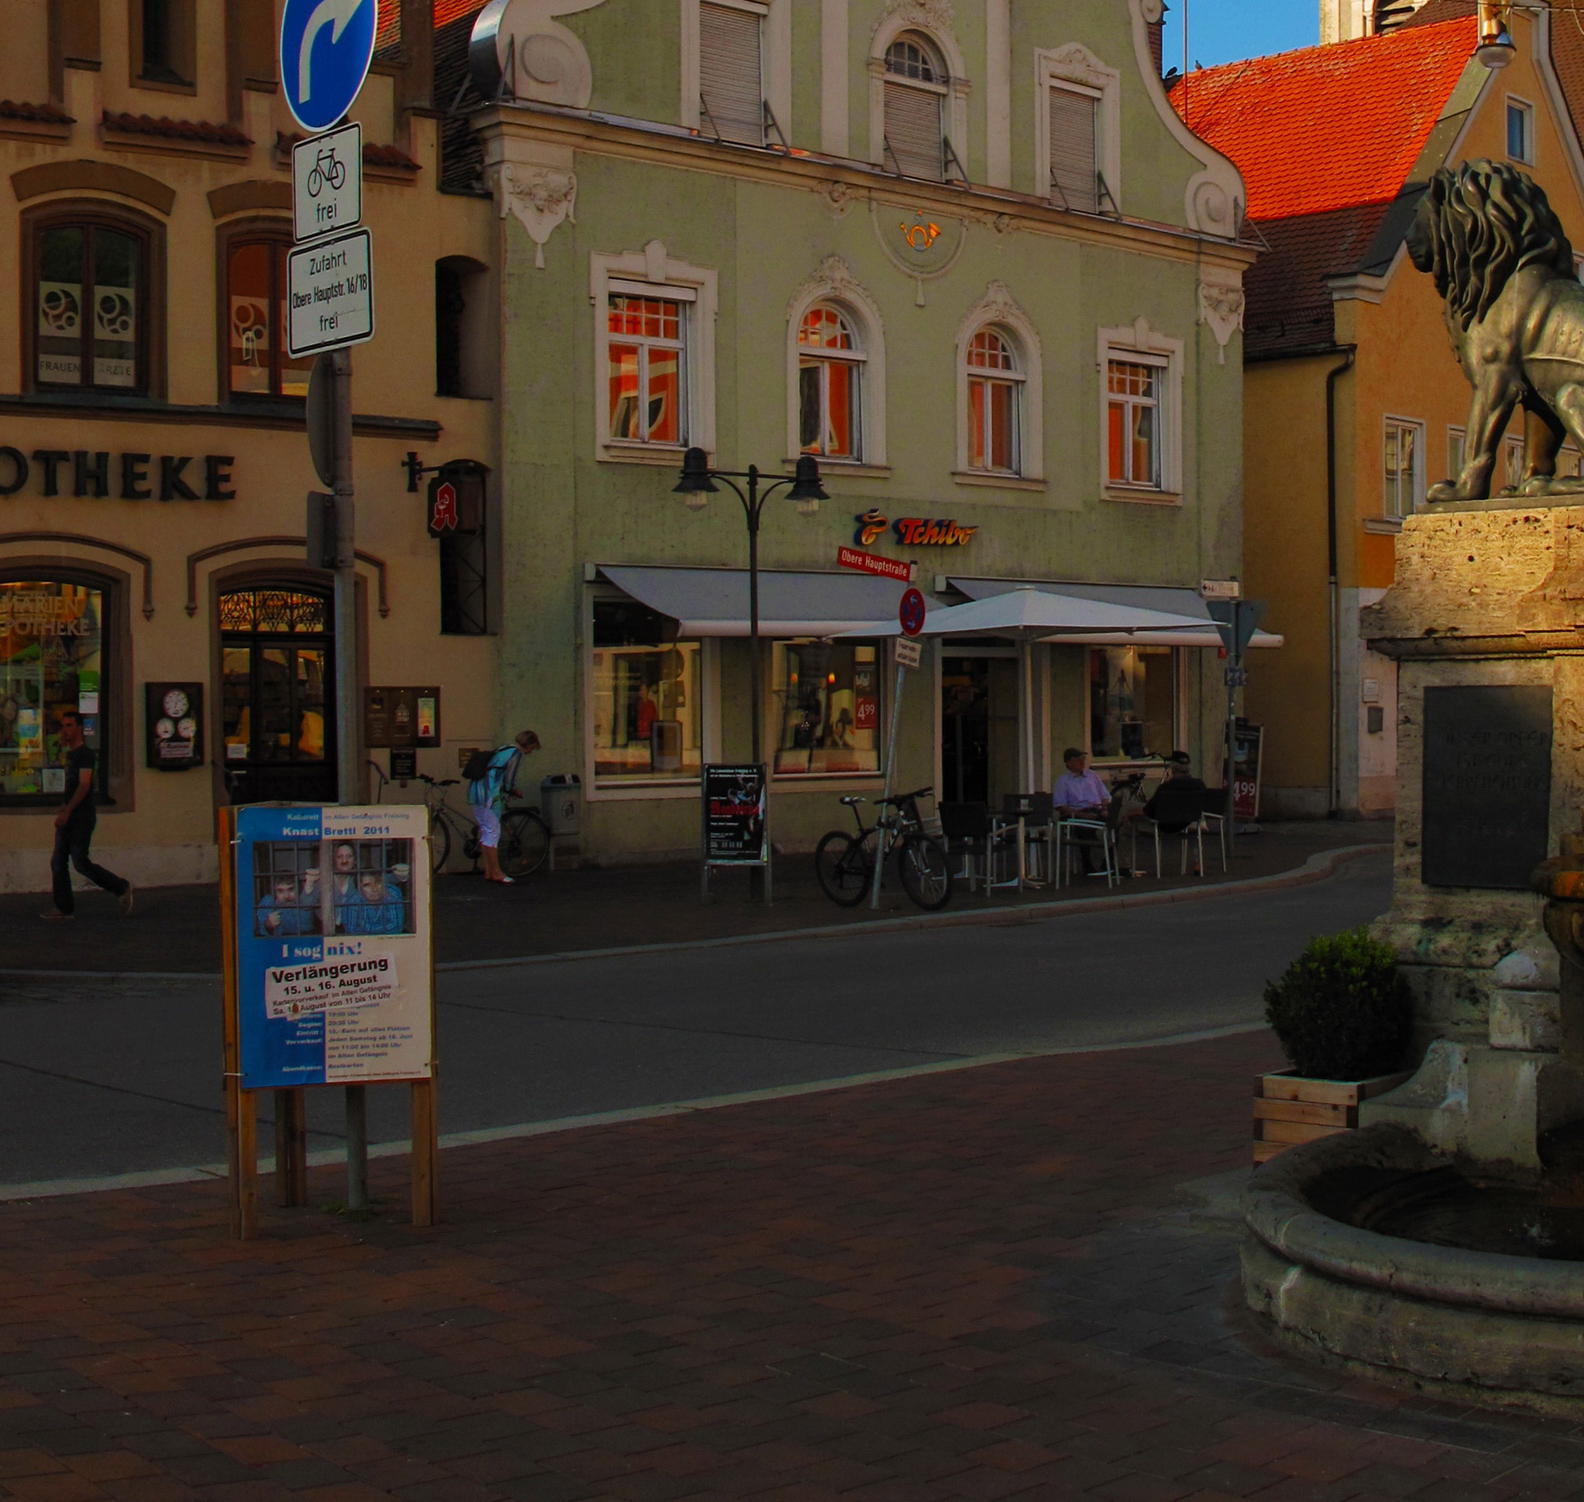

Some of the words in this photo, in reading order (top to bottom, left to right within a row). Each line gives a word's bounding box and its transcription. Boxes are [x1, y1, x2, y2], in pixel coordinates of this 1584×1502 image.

[317, 198, 338, 222] frei
[309, 250, 346, 275] Zufahrt
[293, 291, 312, 309] Obere
[313, 281, 346, 305] Hauptstr.
[346, 273, 368, 295] 16/18
[319, 311, 338, 332] frei
[39, 360, 82, 373] FRAUEN
[898, 518, 978, 546] Tchibo
[841, 549, 862, 565] Obere
[864, 555, 908, 577] Hauptstraße
[286, 813, 319, 821] Kabarett
[383, 812, 410, 820] Freising
[282, 826, 320, 836] Knast
[323, 826, 356, 836] Brettl
[363, 826, 390, 835] 2011
[281, 944, 289, 958] I
[293, 946, 322, 960] sog
[326, 942, 362, 956] nix!
[272, 958, 389, 983] Verlängerung
[273, 993, 329, 1006] Kartenvorverkauf
[341, 989, 358, 997] Alten
[359, 984, 392, 995] Gefängnis
[283, 985, 301, 996] 15.
[304, 985, 315, 993] u.
[318, 981, 335, 991] 16.
[338, 974, 378, 988] August
[273, 1007, 286, 1015] Sa.
[300, 1002, 327, 1012] August
[344, 997, 353, 1005] 11
[354, 995, 366, 1003] bis
[378, 992, 391, 1001] Uhr
